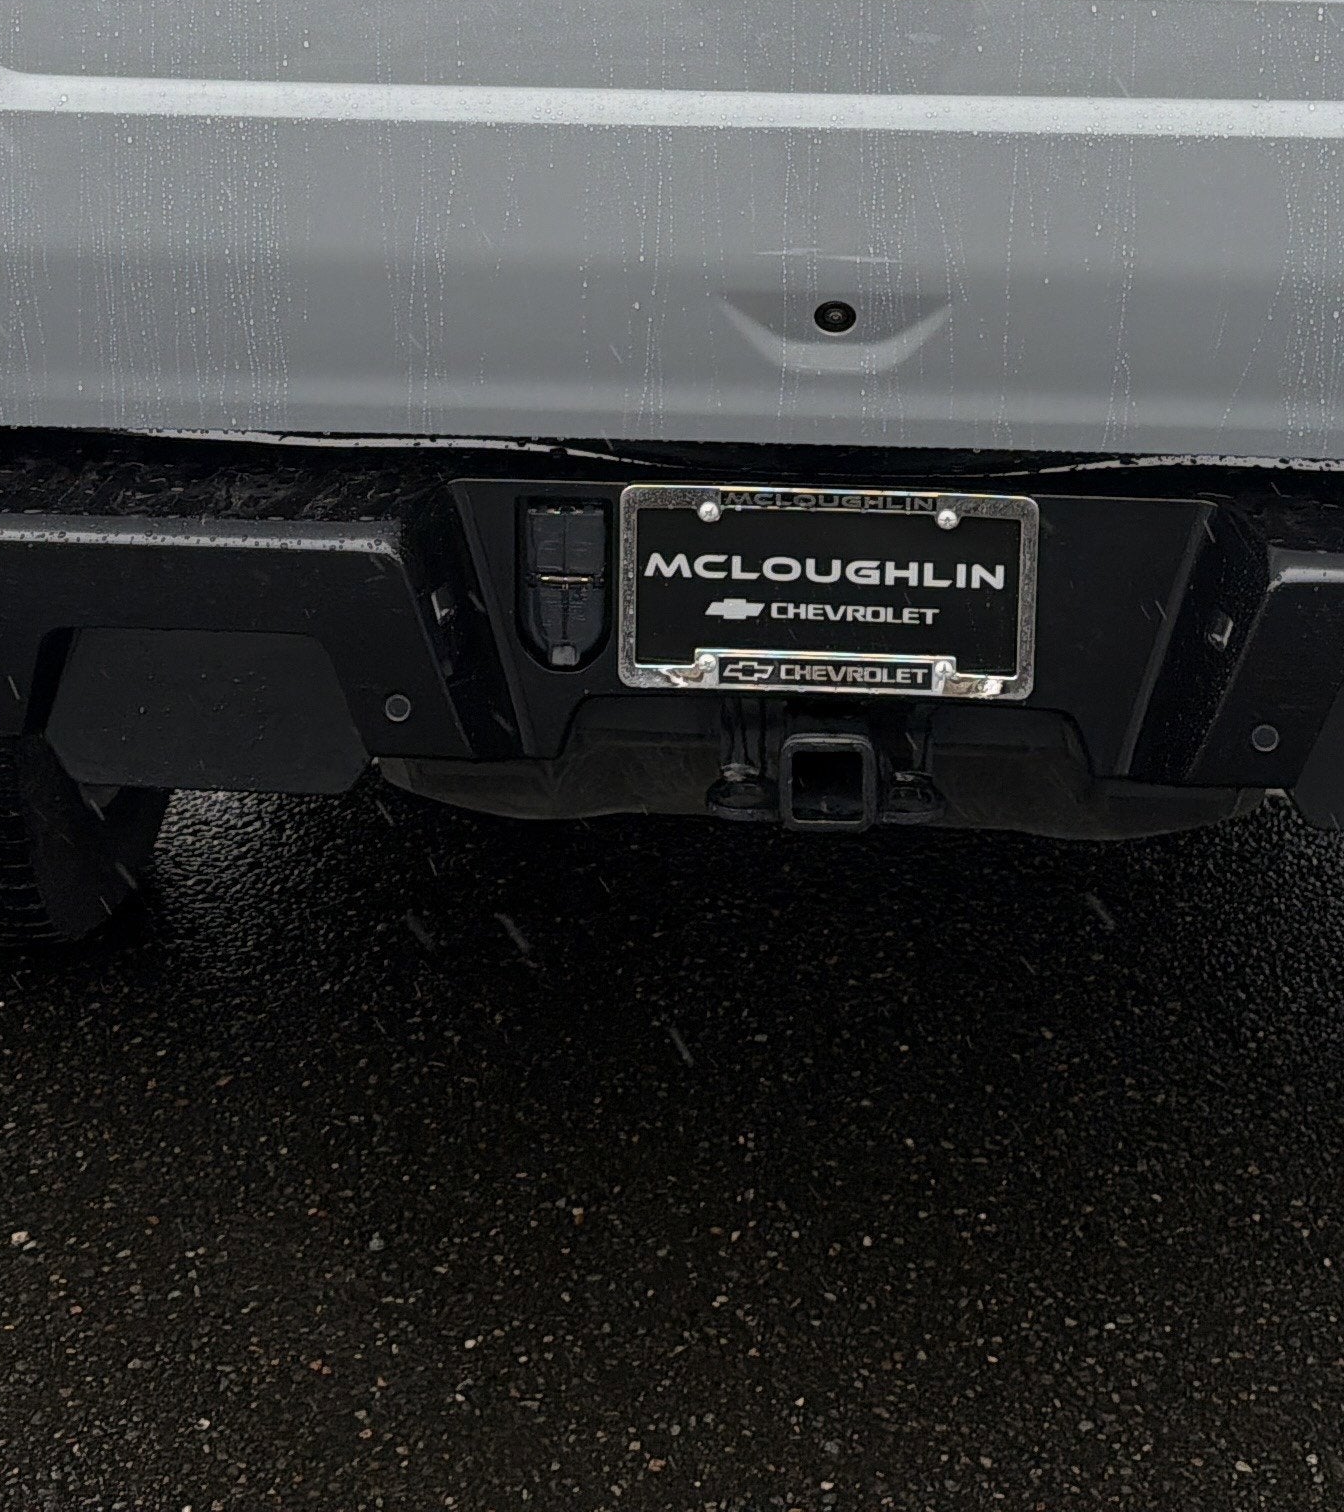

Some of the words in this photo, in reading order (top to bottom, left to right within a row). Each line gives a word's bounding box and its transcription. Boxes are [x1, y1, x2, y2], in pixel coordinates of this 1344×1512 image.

[725, 492, 935, 510] MCLOUGHLIN
[643, 552, 1005, 590] MCLOUGHLIN
[770, 602, 940, 625] CHEVROLET
[779, 664, 929, 684] CHEVROLET
